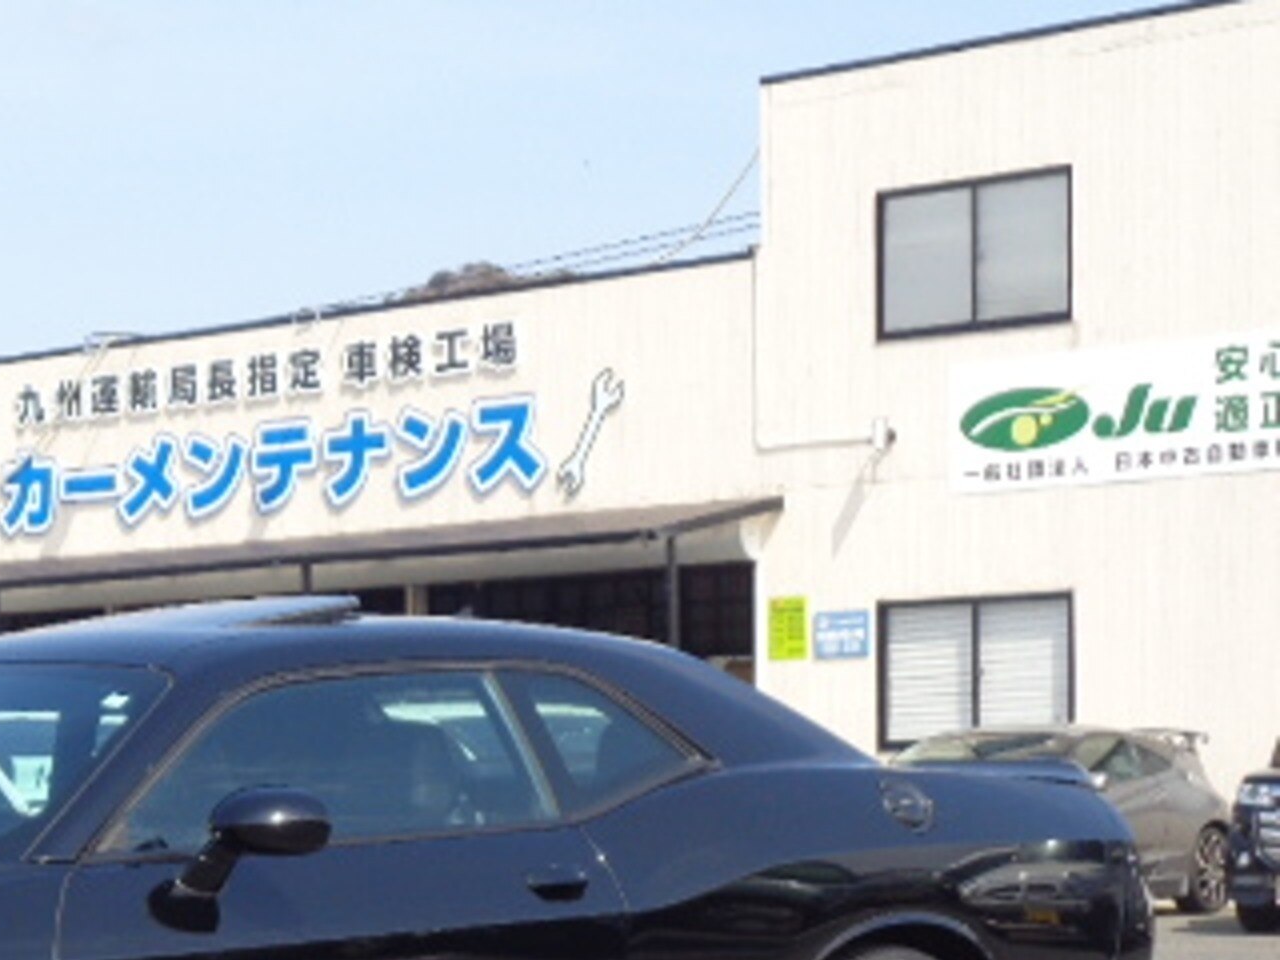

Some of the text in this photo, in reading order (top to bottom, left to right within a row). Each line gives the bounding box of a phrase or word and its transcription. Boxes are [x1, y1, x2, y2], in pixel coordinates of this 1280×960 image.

[16, 322, 518, 424] 九州運輸局長指定 車検工場
[1, 402, 543, 531] カーメンテナンス
